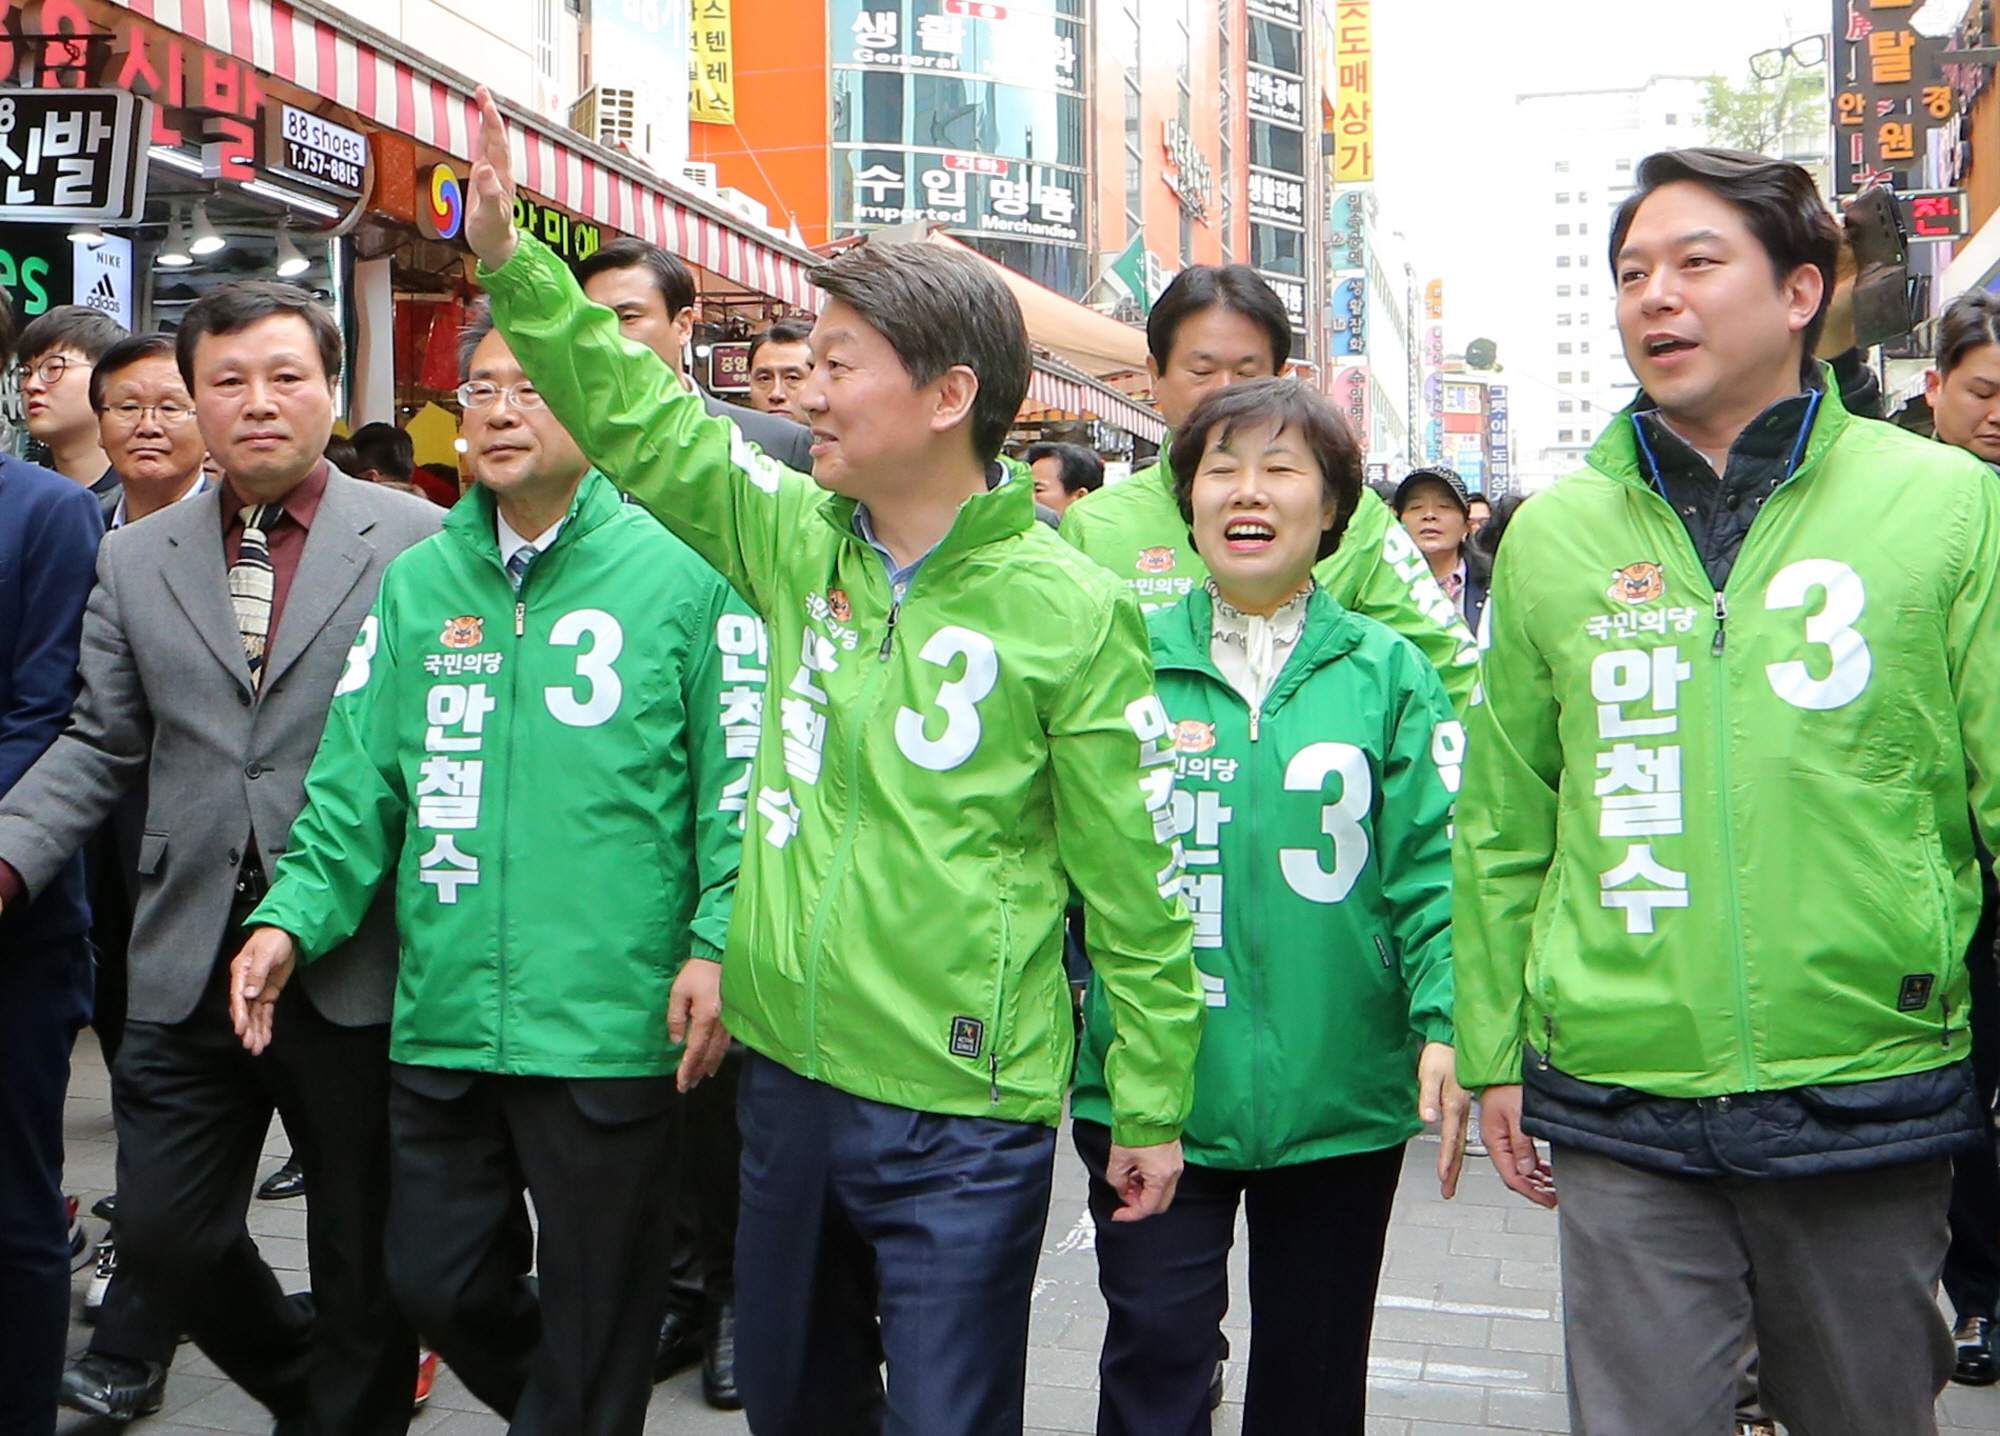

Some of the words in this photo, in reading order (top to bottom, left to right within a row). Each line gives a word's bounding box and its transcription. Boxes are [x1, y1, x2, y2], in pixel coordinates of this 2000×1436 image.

[853, 49, 960, 70] General
[117, 28, 266, 181] 신발
[1838, 92, 1866, 124] 안
[1922, 86, 1952, 119] 경
[287, 112, 310, 141] 88
[312, 124, 361, 160] shoes
[1879, 122, 1915, 160] 원
[290, 146, 359, 188] T.757-8815
[854, 165, 1077, 222] 수입명품
[853, 203, 967, 224] Imported
[981, 214, 1078, 240] Merchandise
[96, 252, 121, 268] NIKE
[86, 295, 121, 314] adidas
[1586, 606, 1698, 641] 국민의당
[1765, 558, 1873, 711] 3
[424, 652, 503, 677] 국민의당
[543, 609, 624, 728] 3
[894, 625, 998, 771] 3
[416, 683, 497, 905] 안철수
[1590, 645, 1692, 935] 안철수
[1278, 741, 1373, 904] 3
